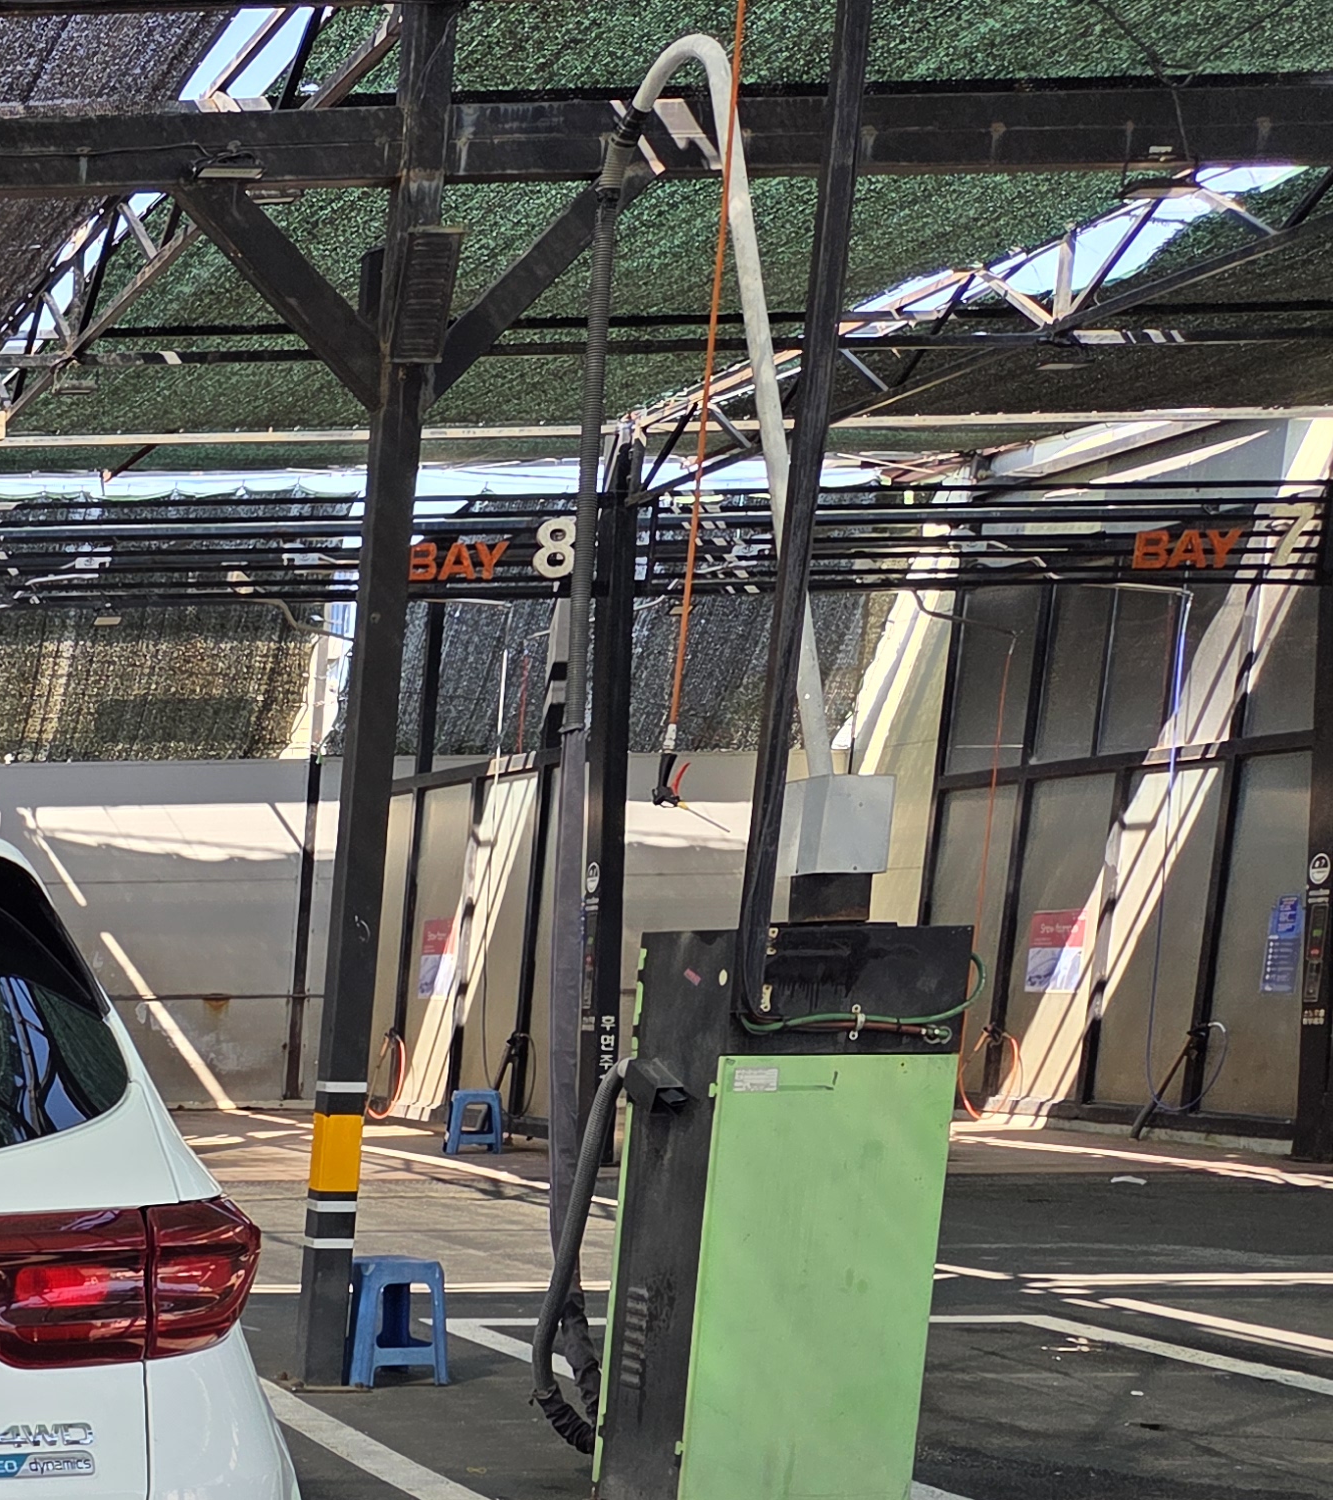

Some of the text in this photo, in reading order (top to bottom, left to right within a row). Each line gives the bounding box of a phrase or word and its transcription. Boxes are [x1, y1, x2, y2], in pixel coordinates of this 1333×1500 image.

[408, 516, 576, 580] BAY 8
[1132, 503, 1316, 568] BAY 7
[599, 1015, 616, 1080] 후면주
[28, 1457, 92, 1475] dynamics
